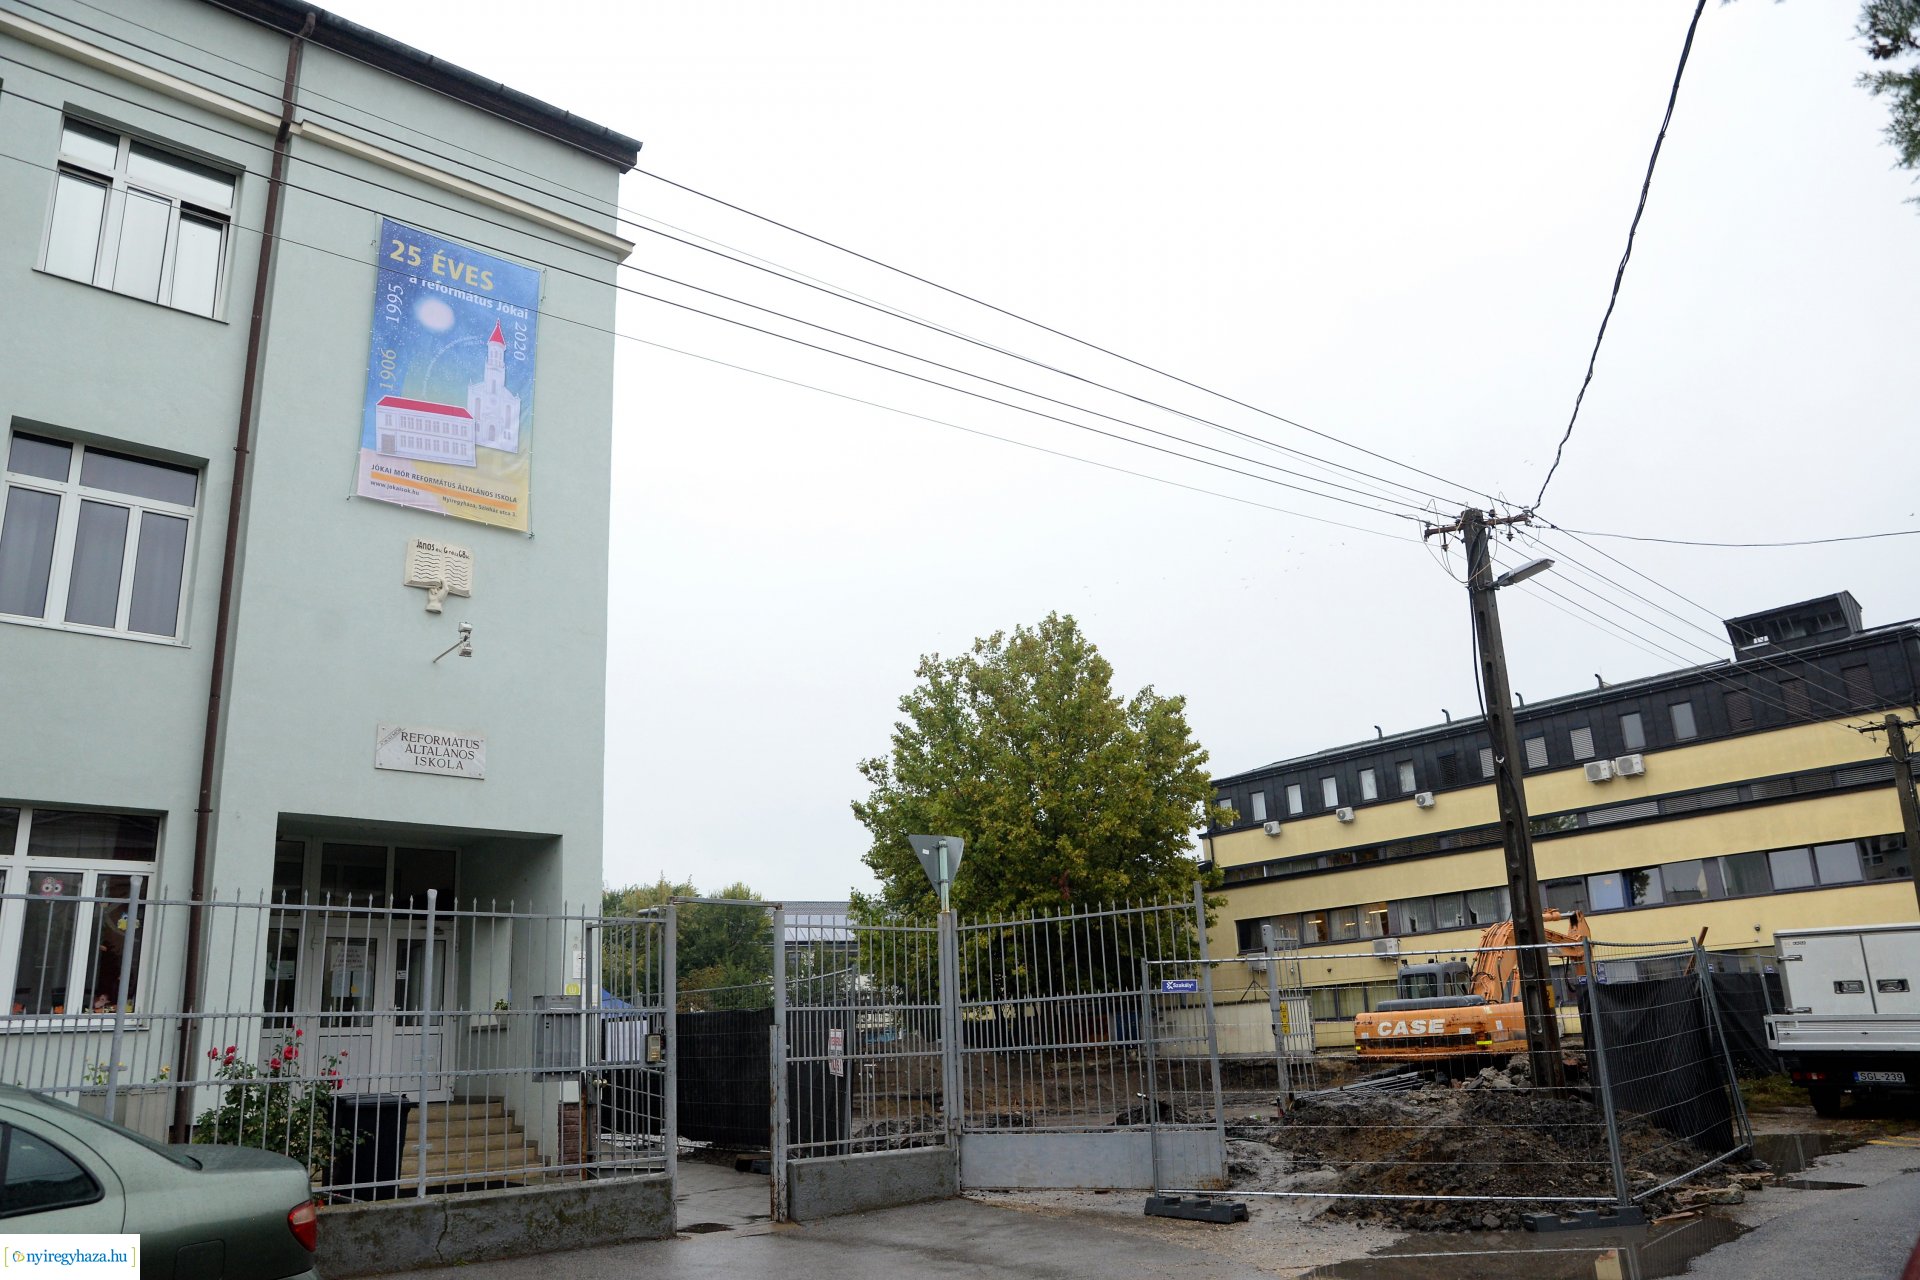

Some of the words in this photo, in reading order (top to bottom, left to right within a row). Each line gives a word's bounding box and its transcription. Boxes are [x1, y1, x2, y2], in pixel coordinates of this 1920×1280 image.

[390, 240, 422, 267] 25
[432, 249, 494, 291] ÉVES
[409, 276, 417, 285] a
[386, 284, 404, 324] 1995
[514, 322, 527, 361] 2020
[379, 348, 396, 391] 1906
[371, 463, 392, 475] JÓKAI
[394, 469, 410, 479] MÓR
[412, 473, 456, 489] REFORMÁTUS
[457, 483, 494, 499] ÁLTALÁNOS
[494, 491, 518, 504] ISKOLA
[415, 755, 464, 770] ISKOLA
[1377, 1018, 1445, 1036] CASE
[1860, 1072, 1903, 1081] SGL-239
